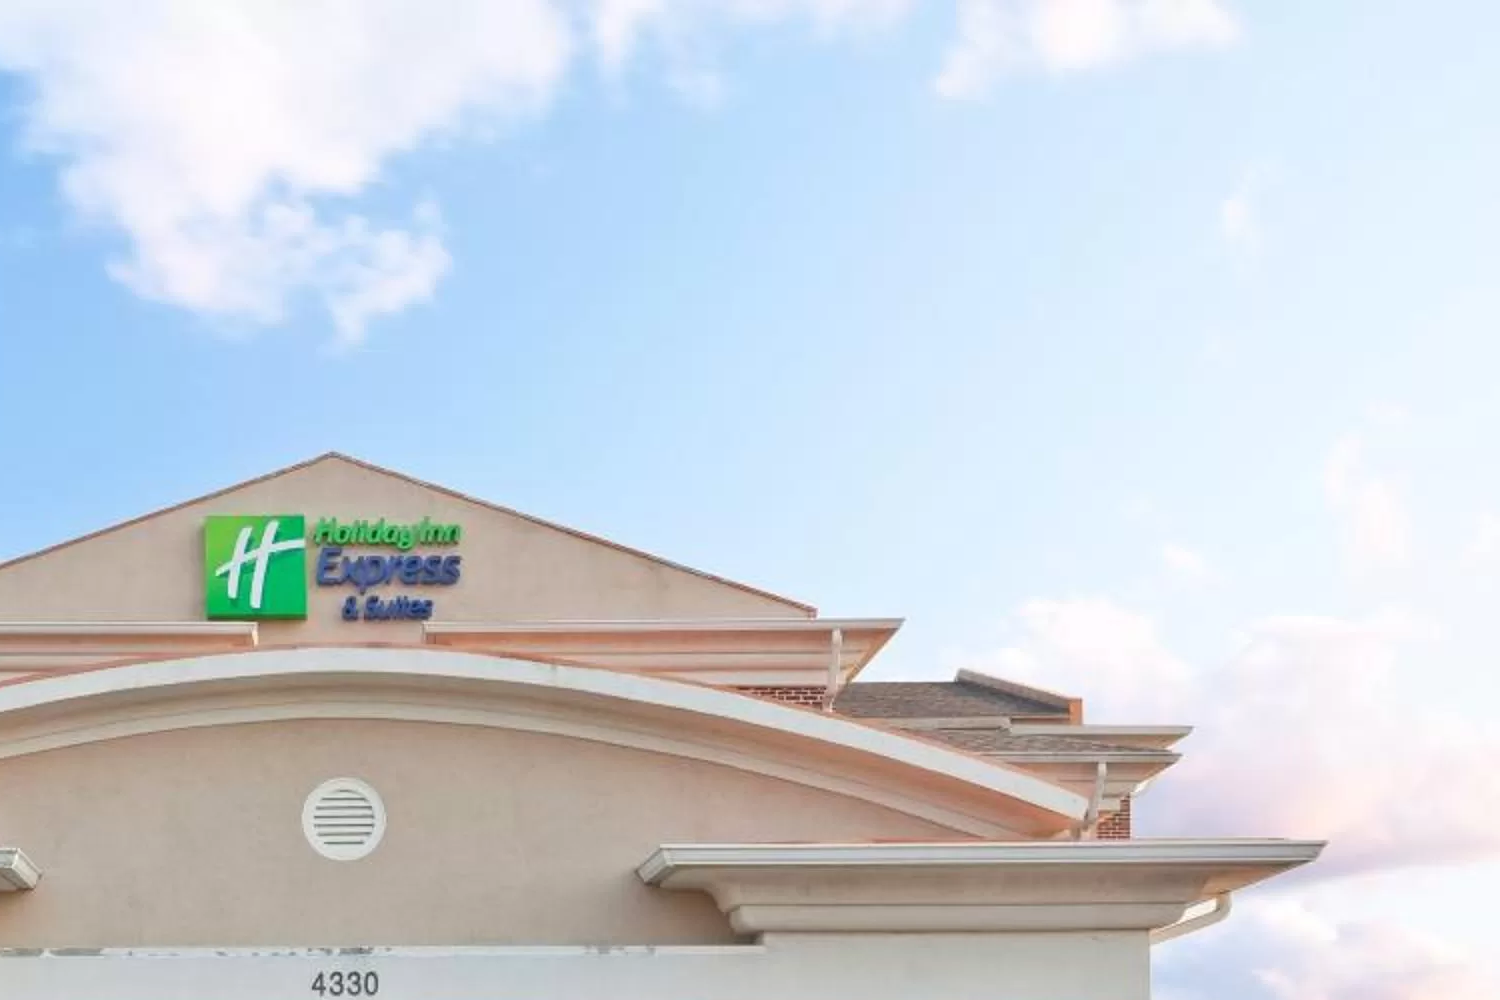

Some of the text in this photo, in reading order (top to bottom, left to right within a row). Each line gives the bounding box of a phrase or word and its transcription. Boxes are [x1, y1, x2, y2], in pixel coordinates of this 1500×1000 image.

[314, 516, 461, 550] Holiday Inn
[316, 547, 462, 595] Express
[342, 596, 433, 620] & Suites
[311, 971, 379, 997] 4330
